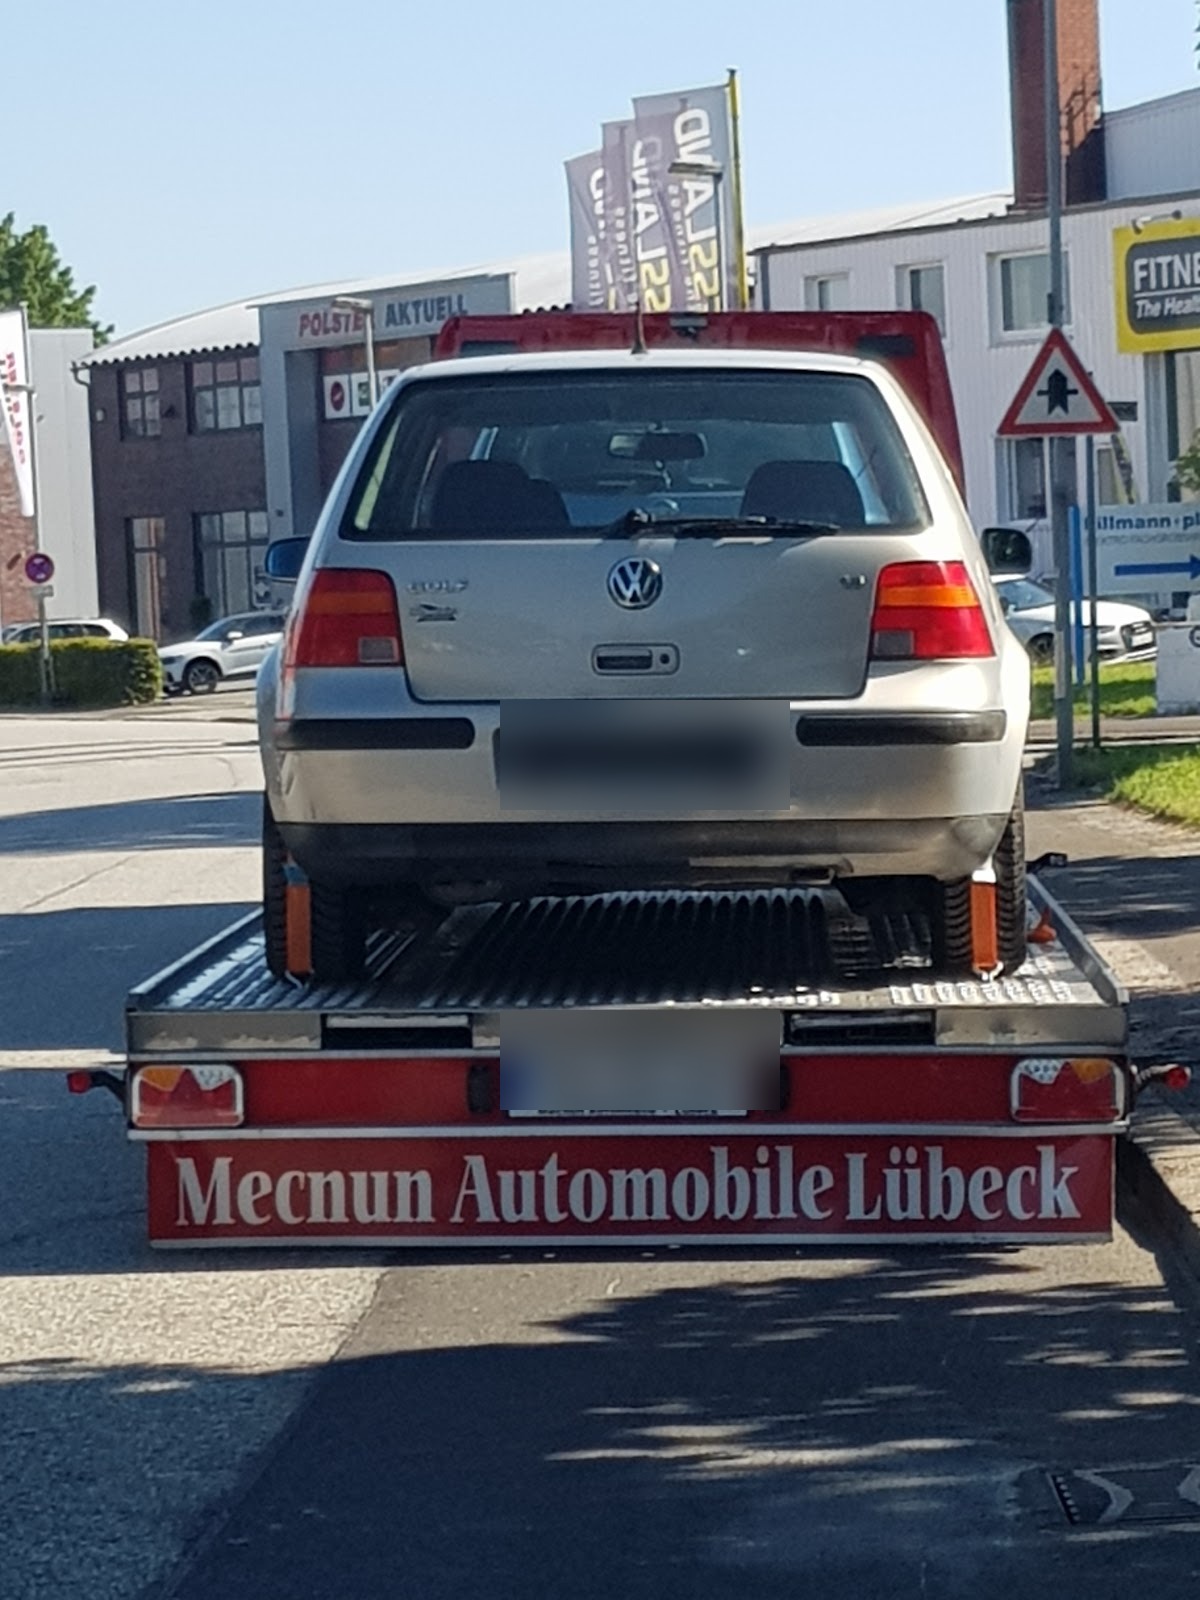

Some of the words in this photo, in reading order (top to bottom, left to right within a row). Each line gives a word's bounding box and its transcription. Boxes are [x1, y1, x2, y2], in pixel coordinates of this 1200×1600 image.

[299, 308, 374, 338] POLSTE
[385, 294, 468, 327] AKTUELL
[1136, 299, 1161, 319] The
[176, 1155, 435, 1226] Mecnun
[450, 1146, 835, 1224] Automobile
[845, 1146, 1082, 1221] Lübeck
